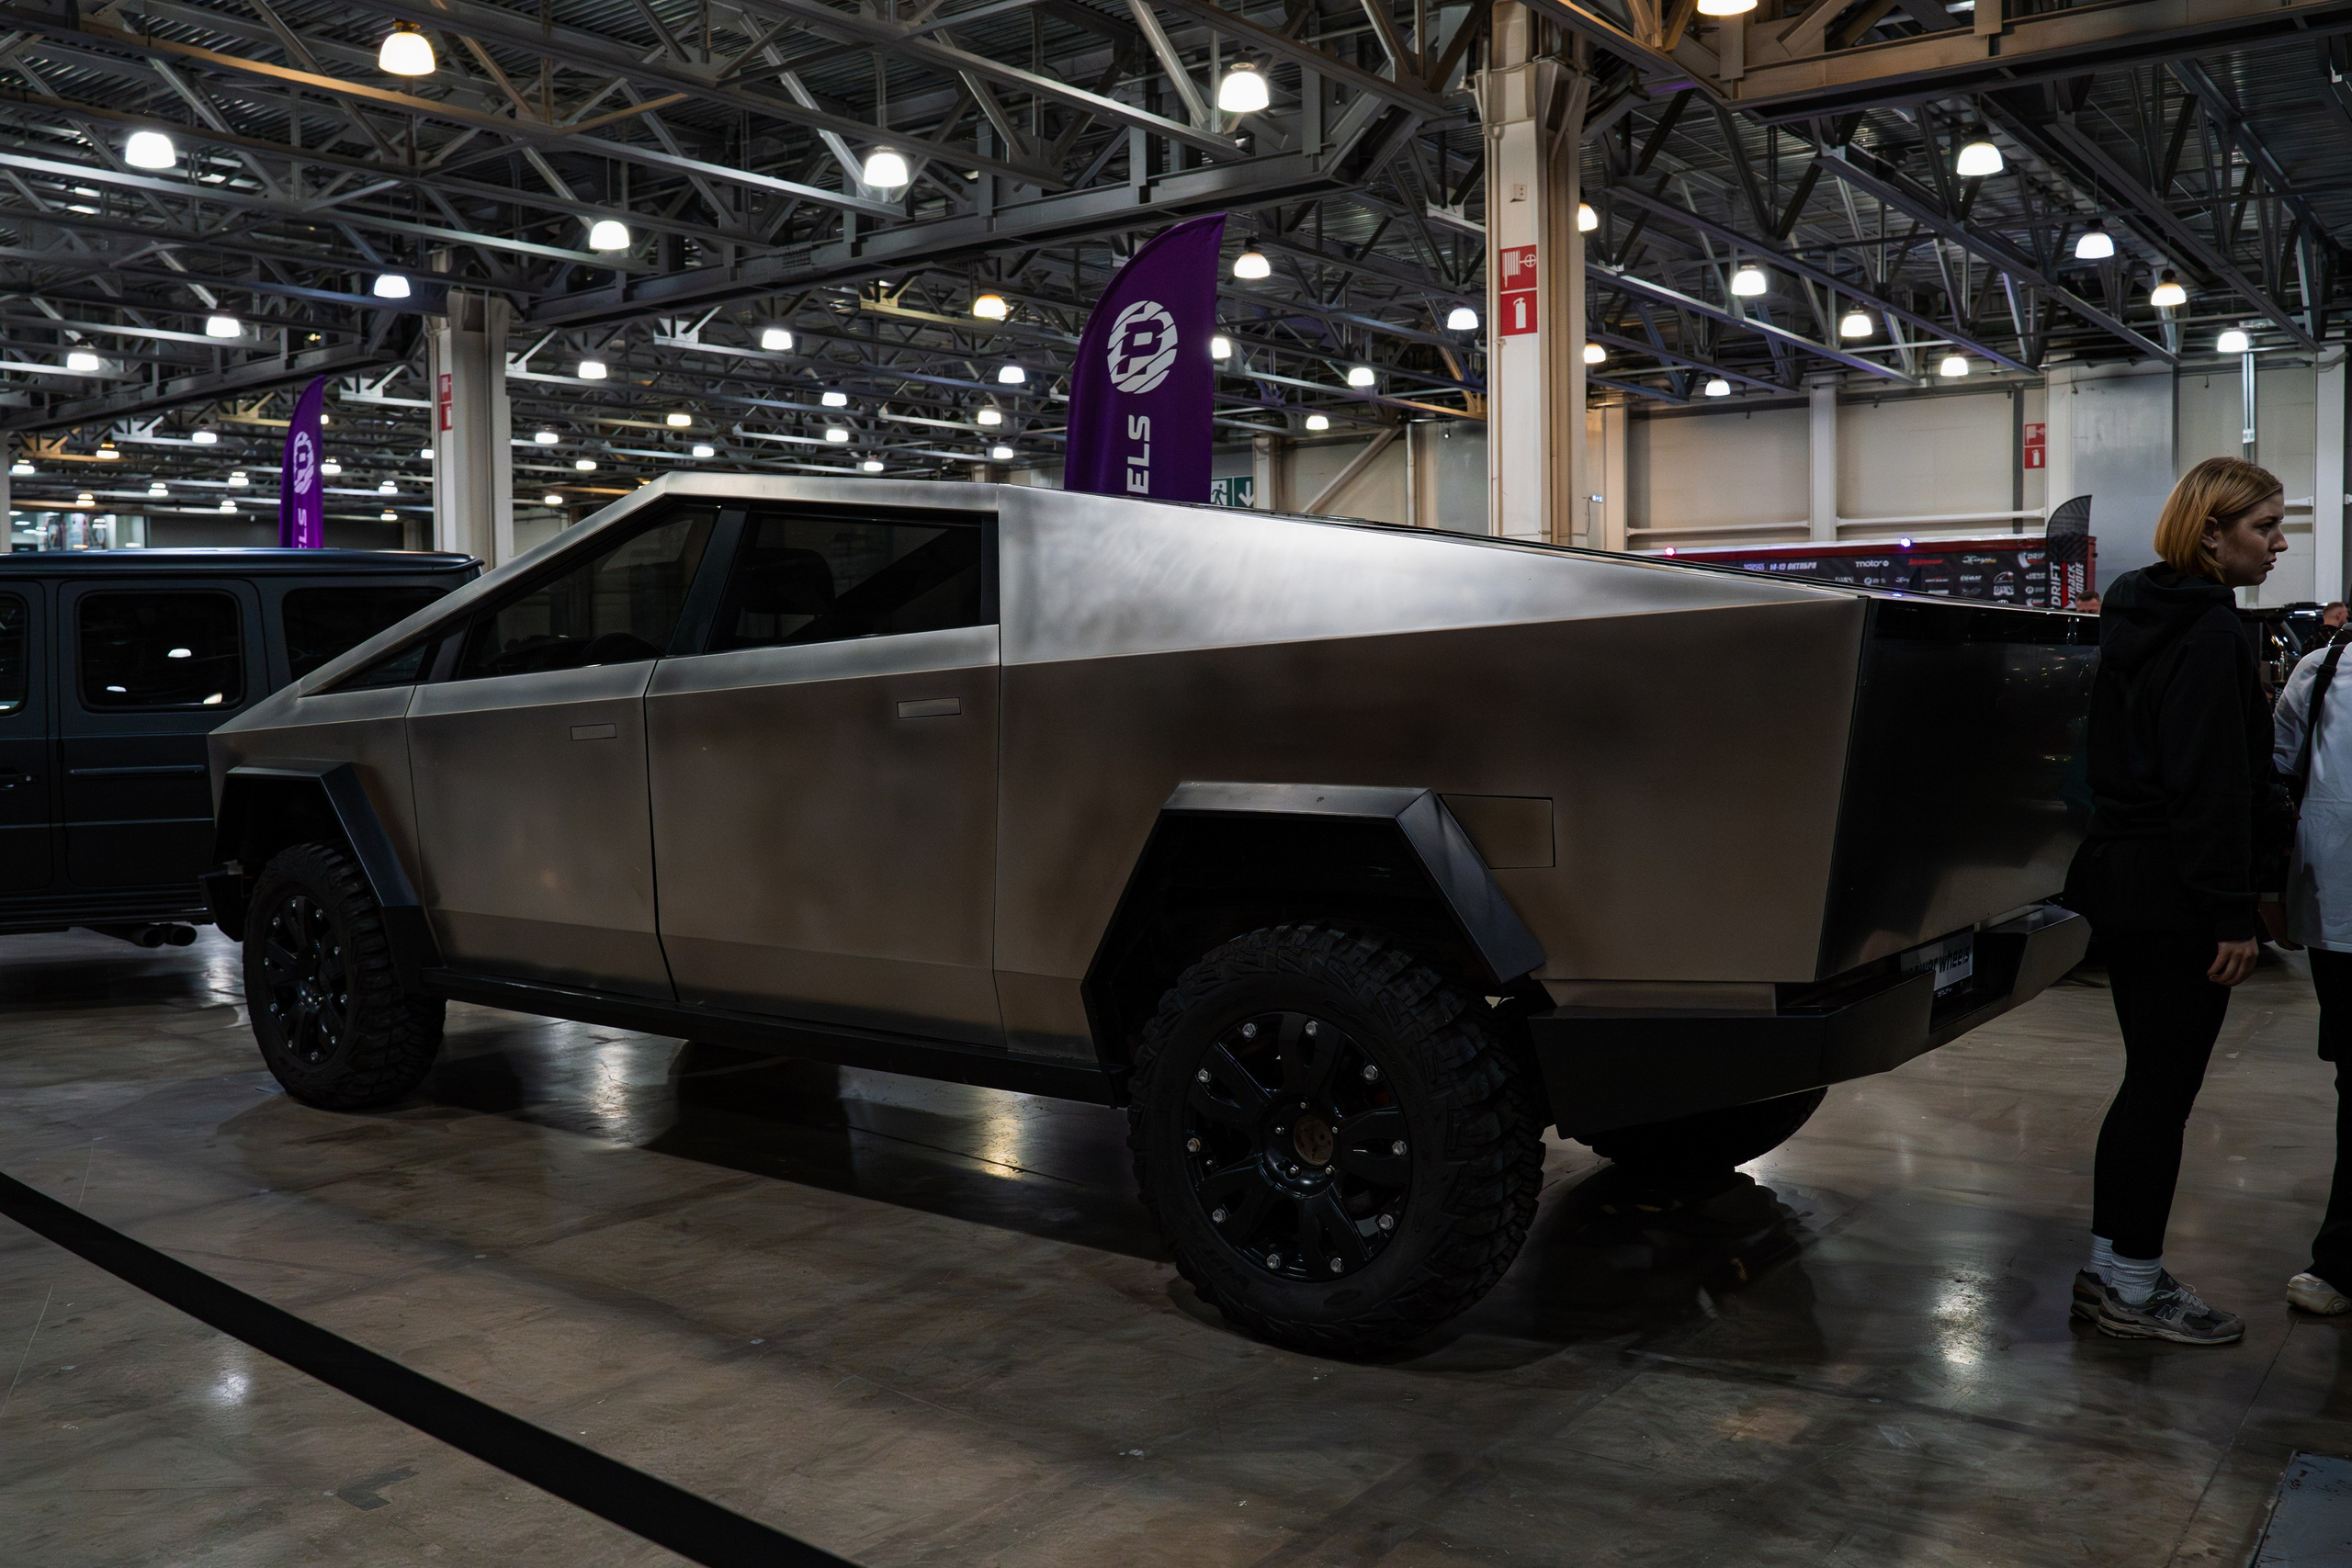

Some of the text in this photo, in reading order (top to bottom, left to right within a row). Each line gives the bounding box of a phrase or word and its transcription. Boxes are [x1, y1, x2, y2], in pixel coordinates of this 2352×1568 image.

[2049, 561, 2062, 607] DRIFT
[2067, 564, 2076, 599] TRACK
[2075, 562, 2085, 593] MODE
